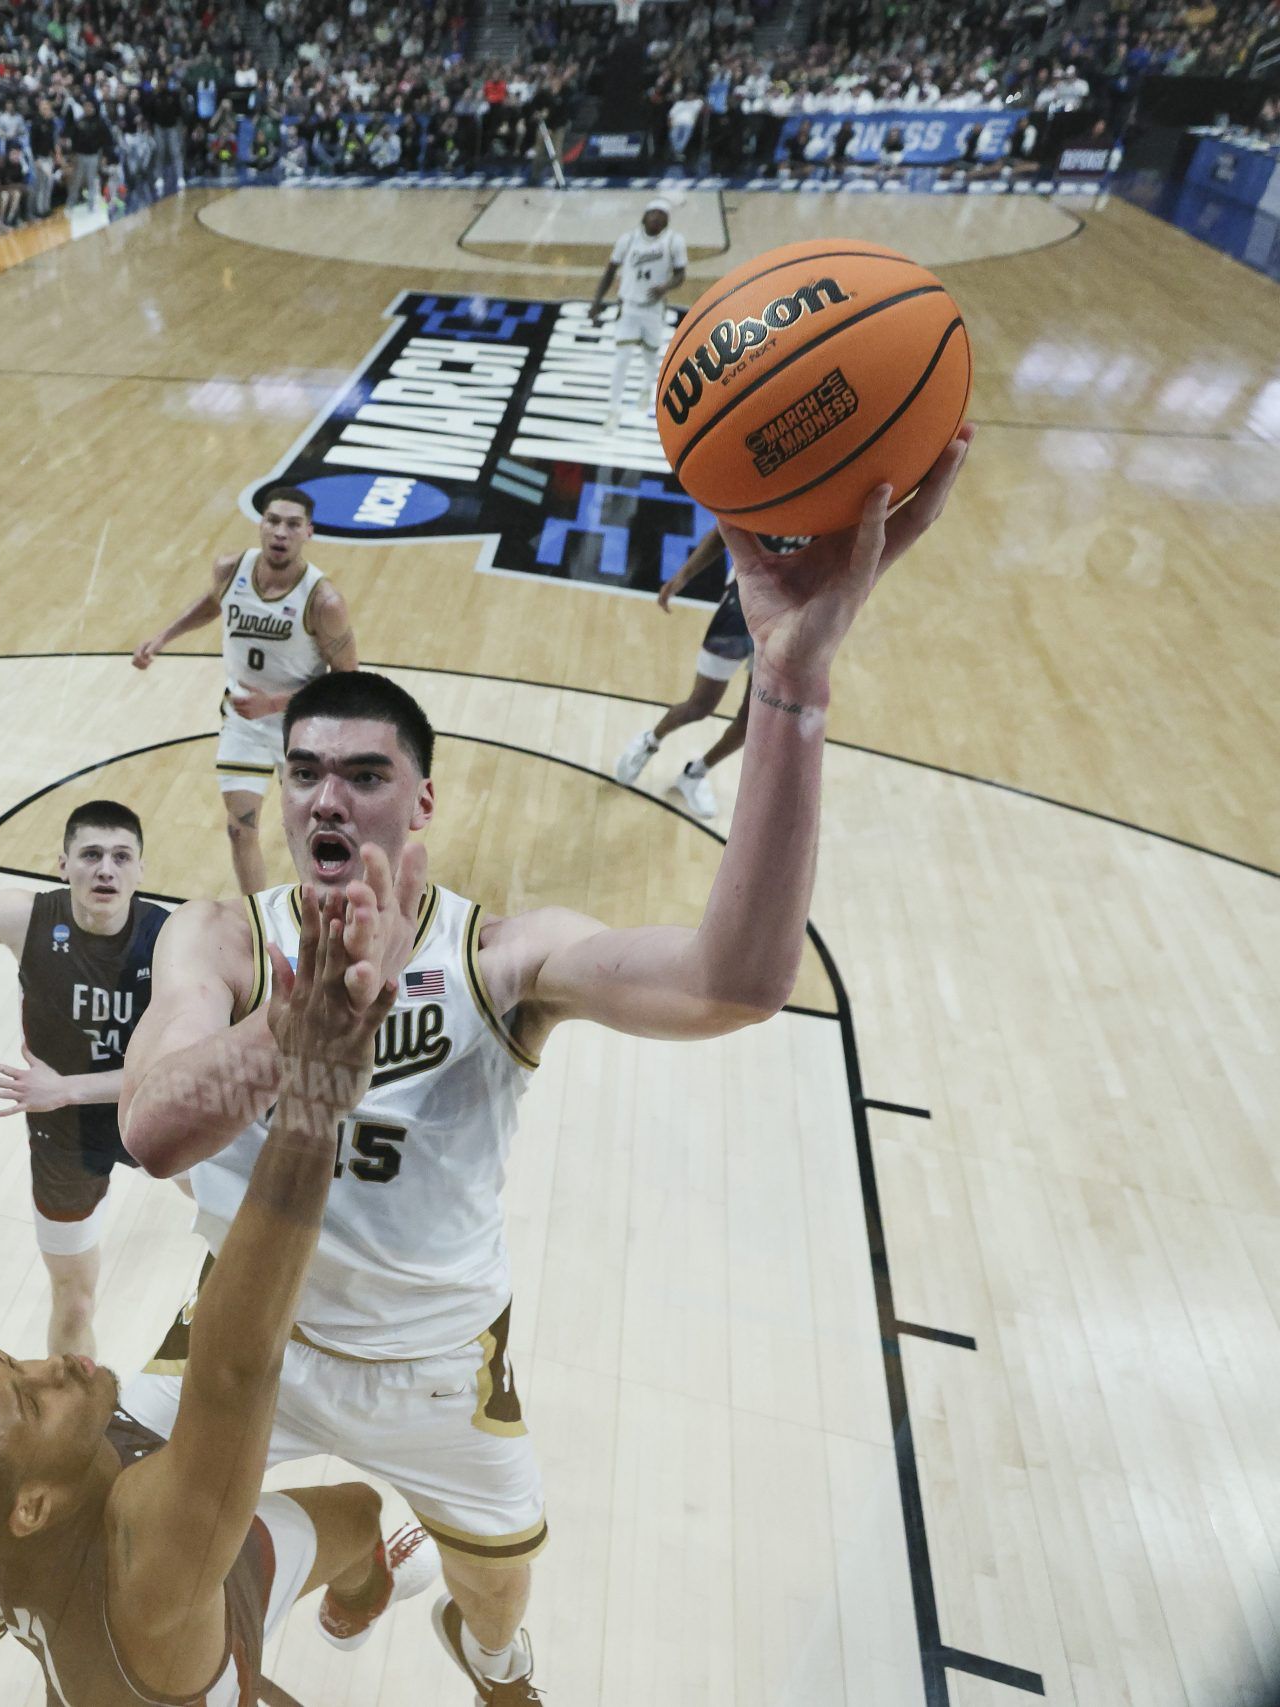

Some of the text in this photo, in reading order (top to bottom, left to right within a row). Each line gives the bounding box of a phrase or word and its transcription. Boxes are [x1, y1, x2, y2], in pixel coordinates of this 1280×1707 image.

[663, 278, 850, 424] Wilson
[323, 337, 530, 481] MARCH
[762, 394, 820, 442] MARCH
[780, 388, 857, 453] MADNESS
[353, 476, 417, 527] NCAA
[226, 603, 293, 640] Purdue
[248, 647, 264, 671] 0
[73, 983, 133, 1024] FDU
